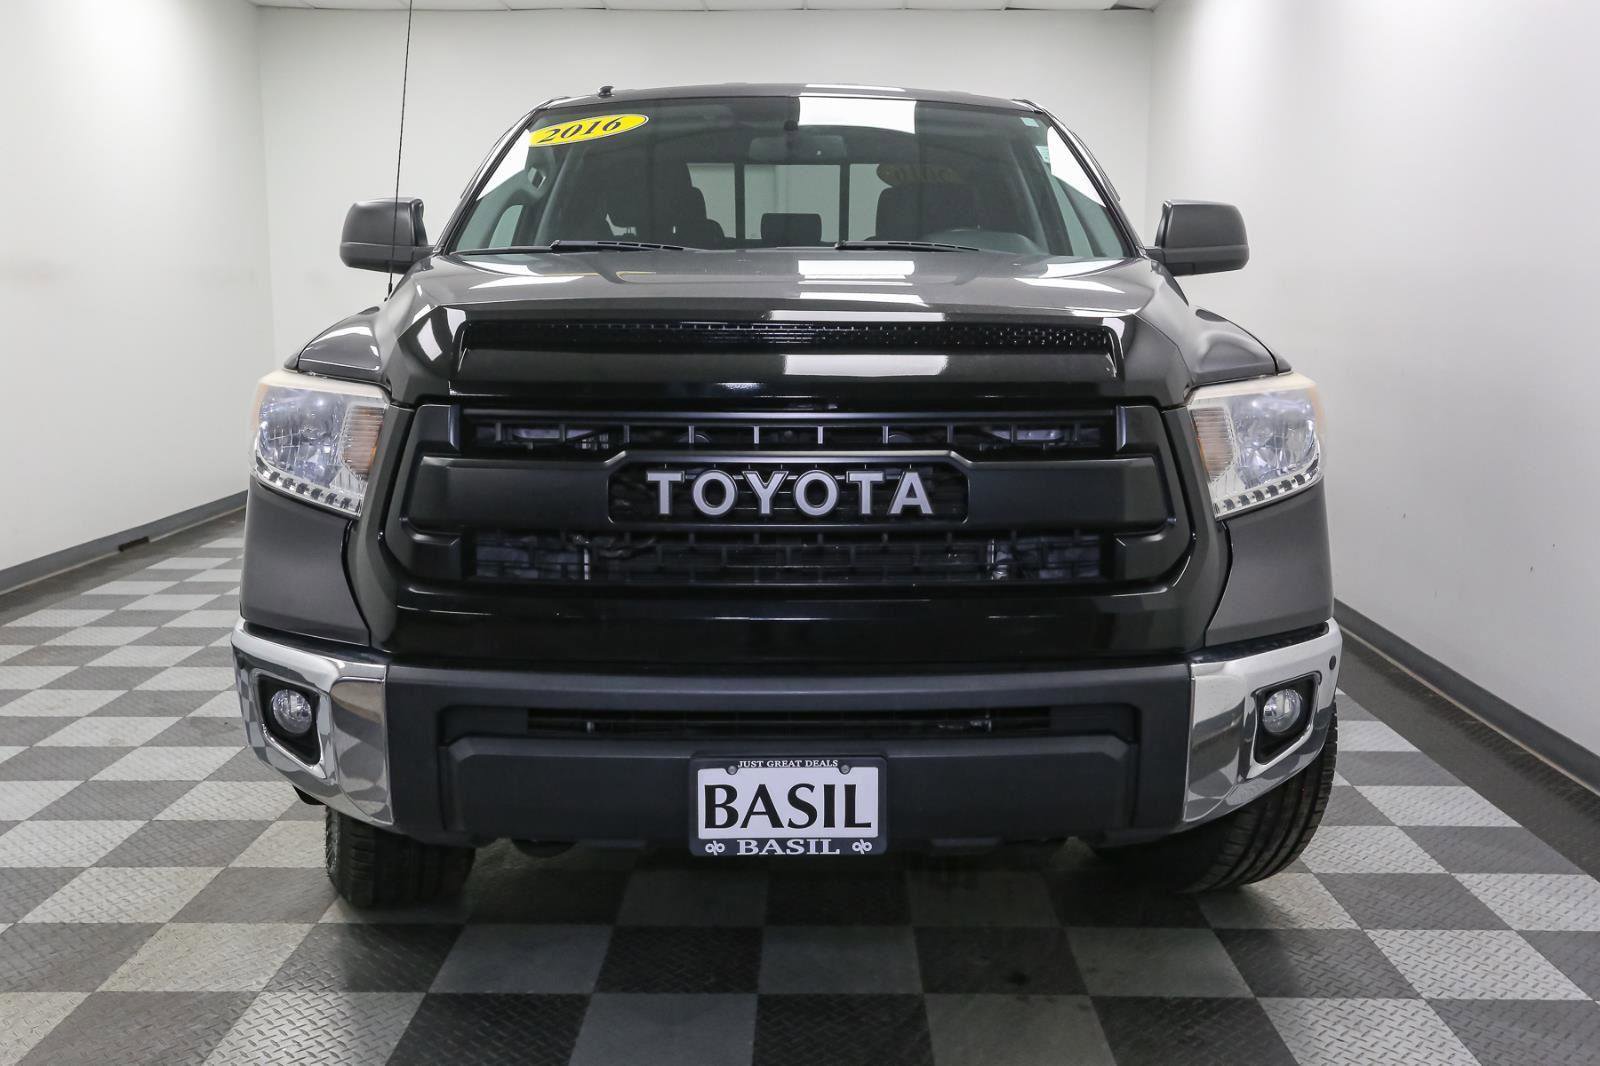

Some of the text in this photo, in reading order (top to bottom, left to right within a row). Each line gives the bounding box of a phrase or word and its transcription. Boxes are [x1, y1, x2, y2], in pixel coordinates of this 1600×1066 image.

[537, 116, 623, 143] 2016
[646, 469, 934, 516] TOYOTA
[738, 759, 839, 769] JUST GREAT DEALS
[704, 783, 872, 830] BASIL
[736, 838, 841, 855] BASIL
